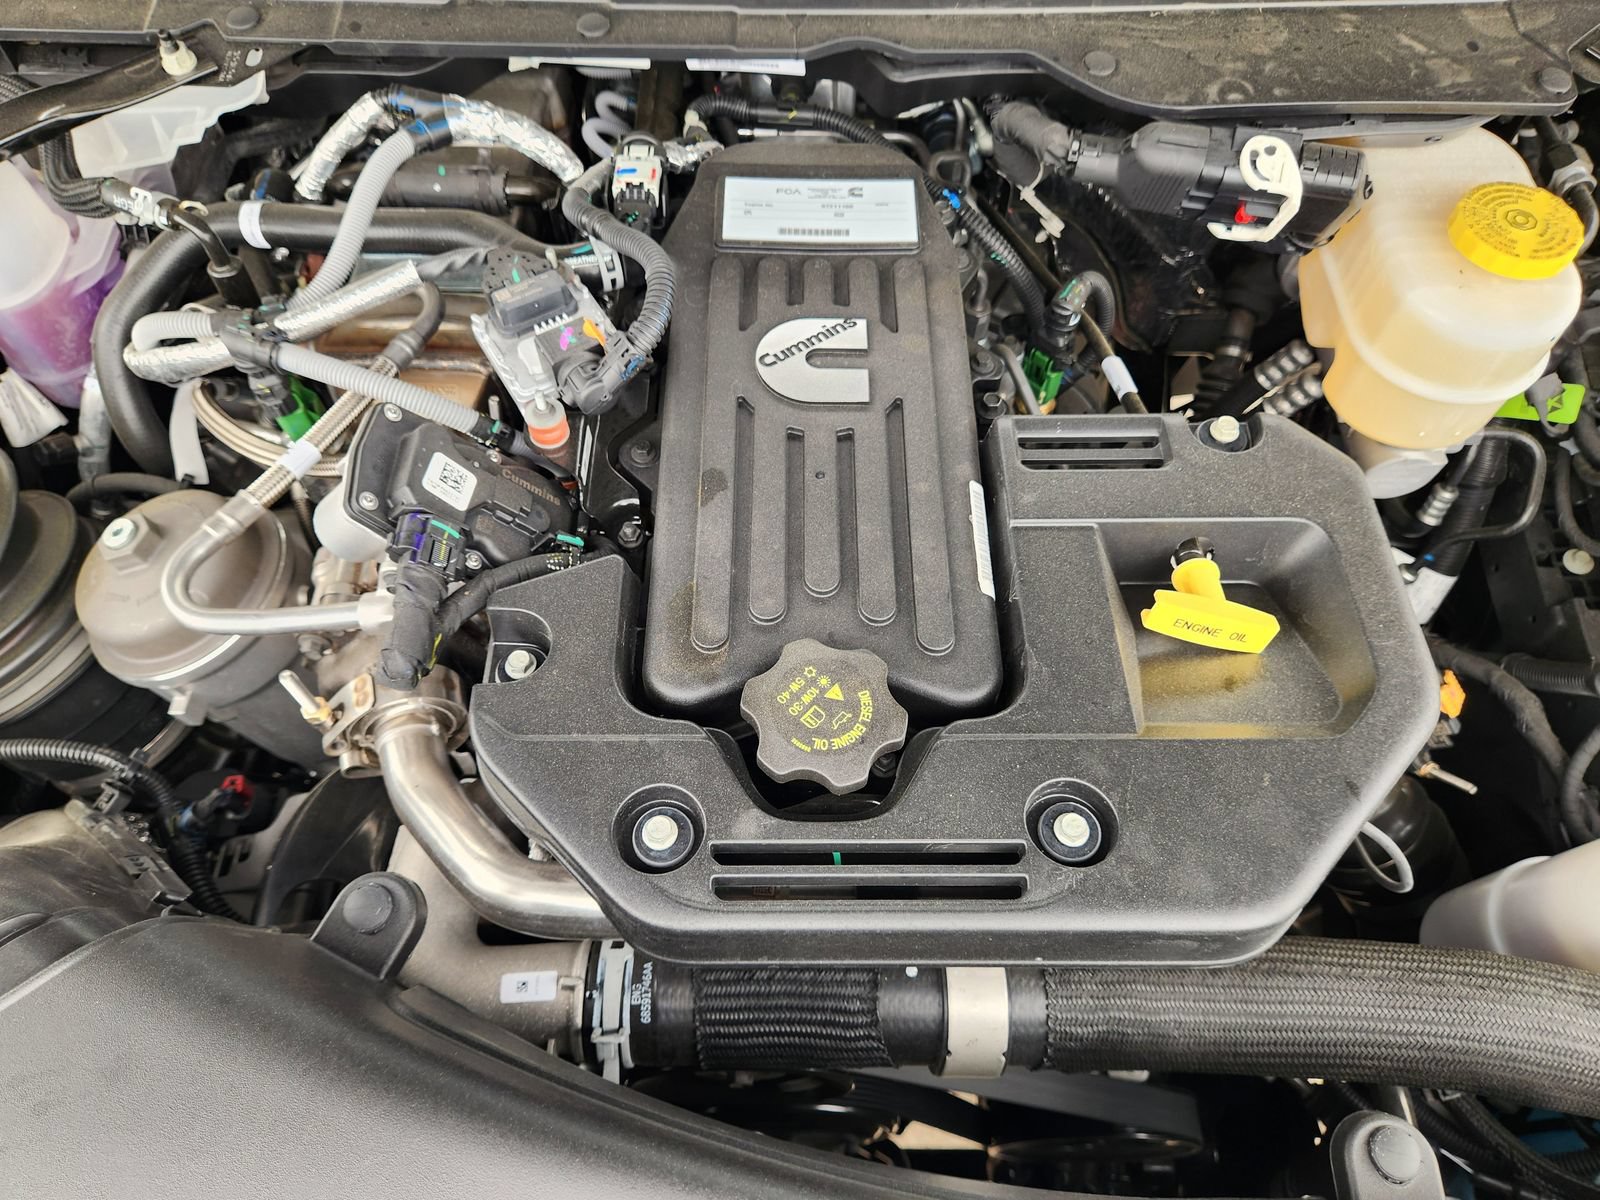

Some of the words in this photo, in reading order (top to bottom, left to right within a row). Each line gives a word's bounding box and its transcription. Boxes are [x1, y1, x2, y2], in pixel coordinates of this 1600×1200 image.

[758, 317, 858, 367] Cummins
[501, 468, 562, 507] Cummins
[1172, 618, 1223, 638] ENGINE
[1228, 631, 1248, 643] OIL
[776, 676, 806, 704] 5W-40
[788, 686, 820, 716] 10W-30
[858, 689, 873, 722] DIESEL
[811, 737, 829, 751] OIL
[830, 723, 867, 750] ENGINE
